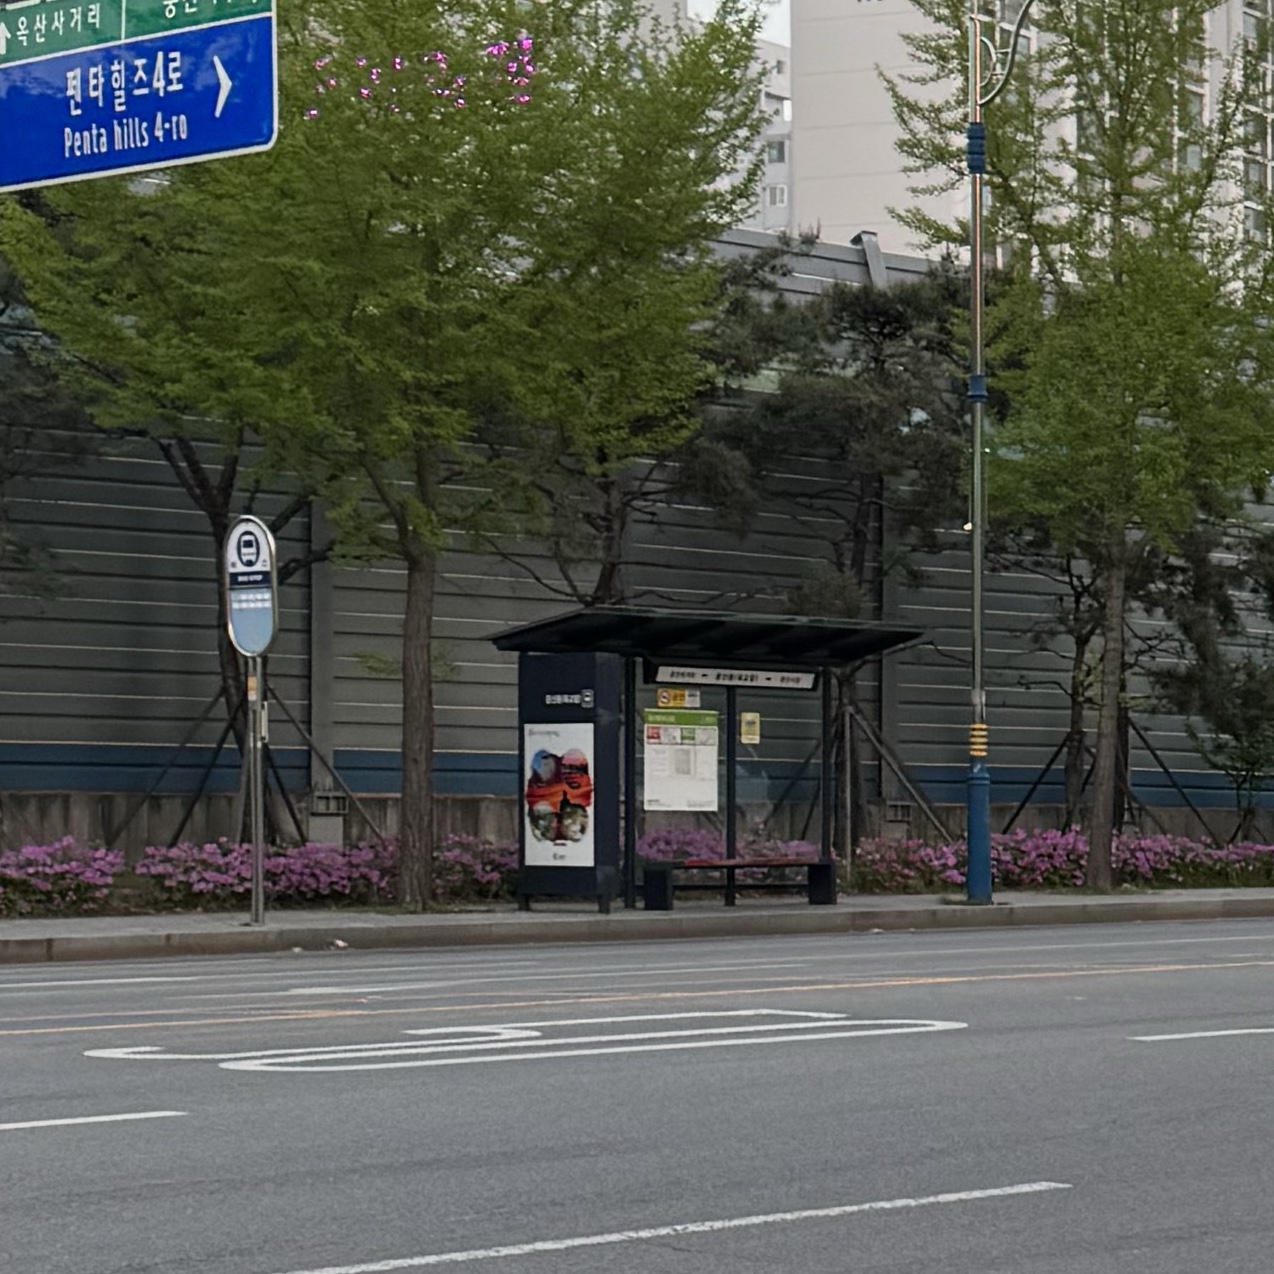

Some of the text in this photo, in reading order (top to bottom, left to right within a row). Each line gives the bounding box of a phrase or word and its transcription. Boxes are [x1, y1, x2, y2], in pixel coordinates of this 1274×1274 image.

[16, 3, 101, 46] 옥산사거리
[65, 51, 184, 116] 펜타힐즈4로
[64, 112, 189, 158] Penta hills 4-ro
